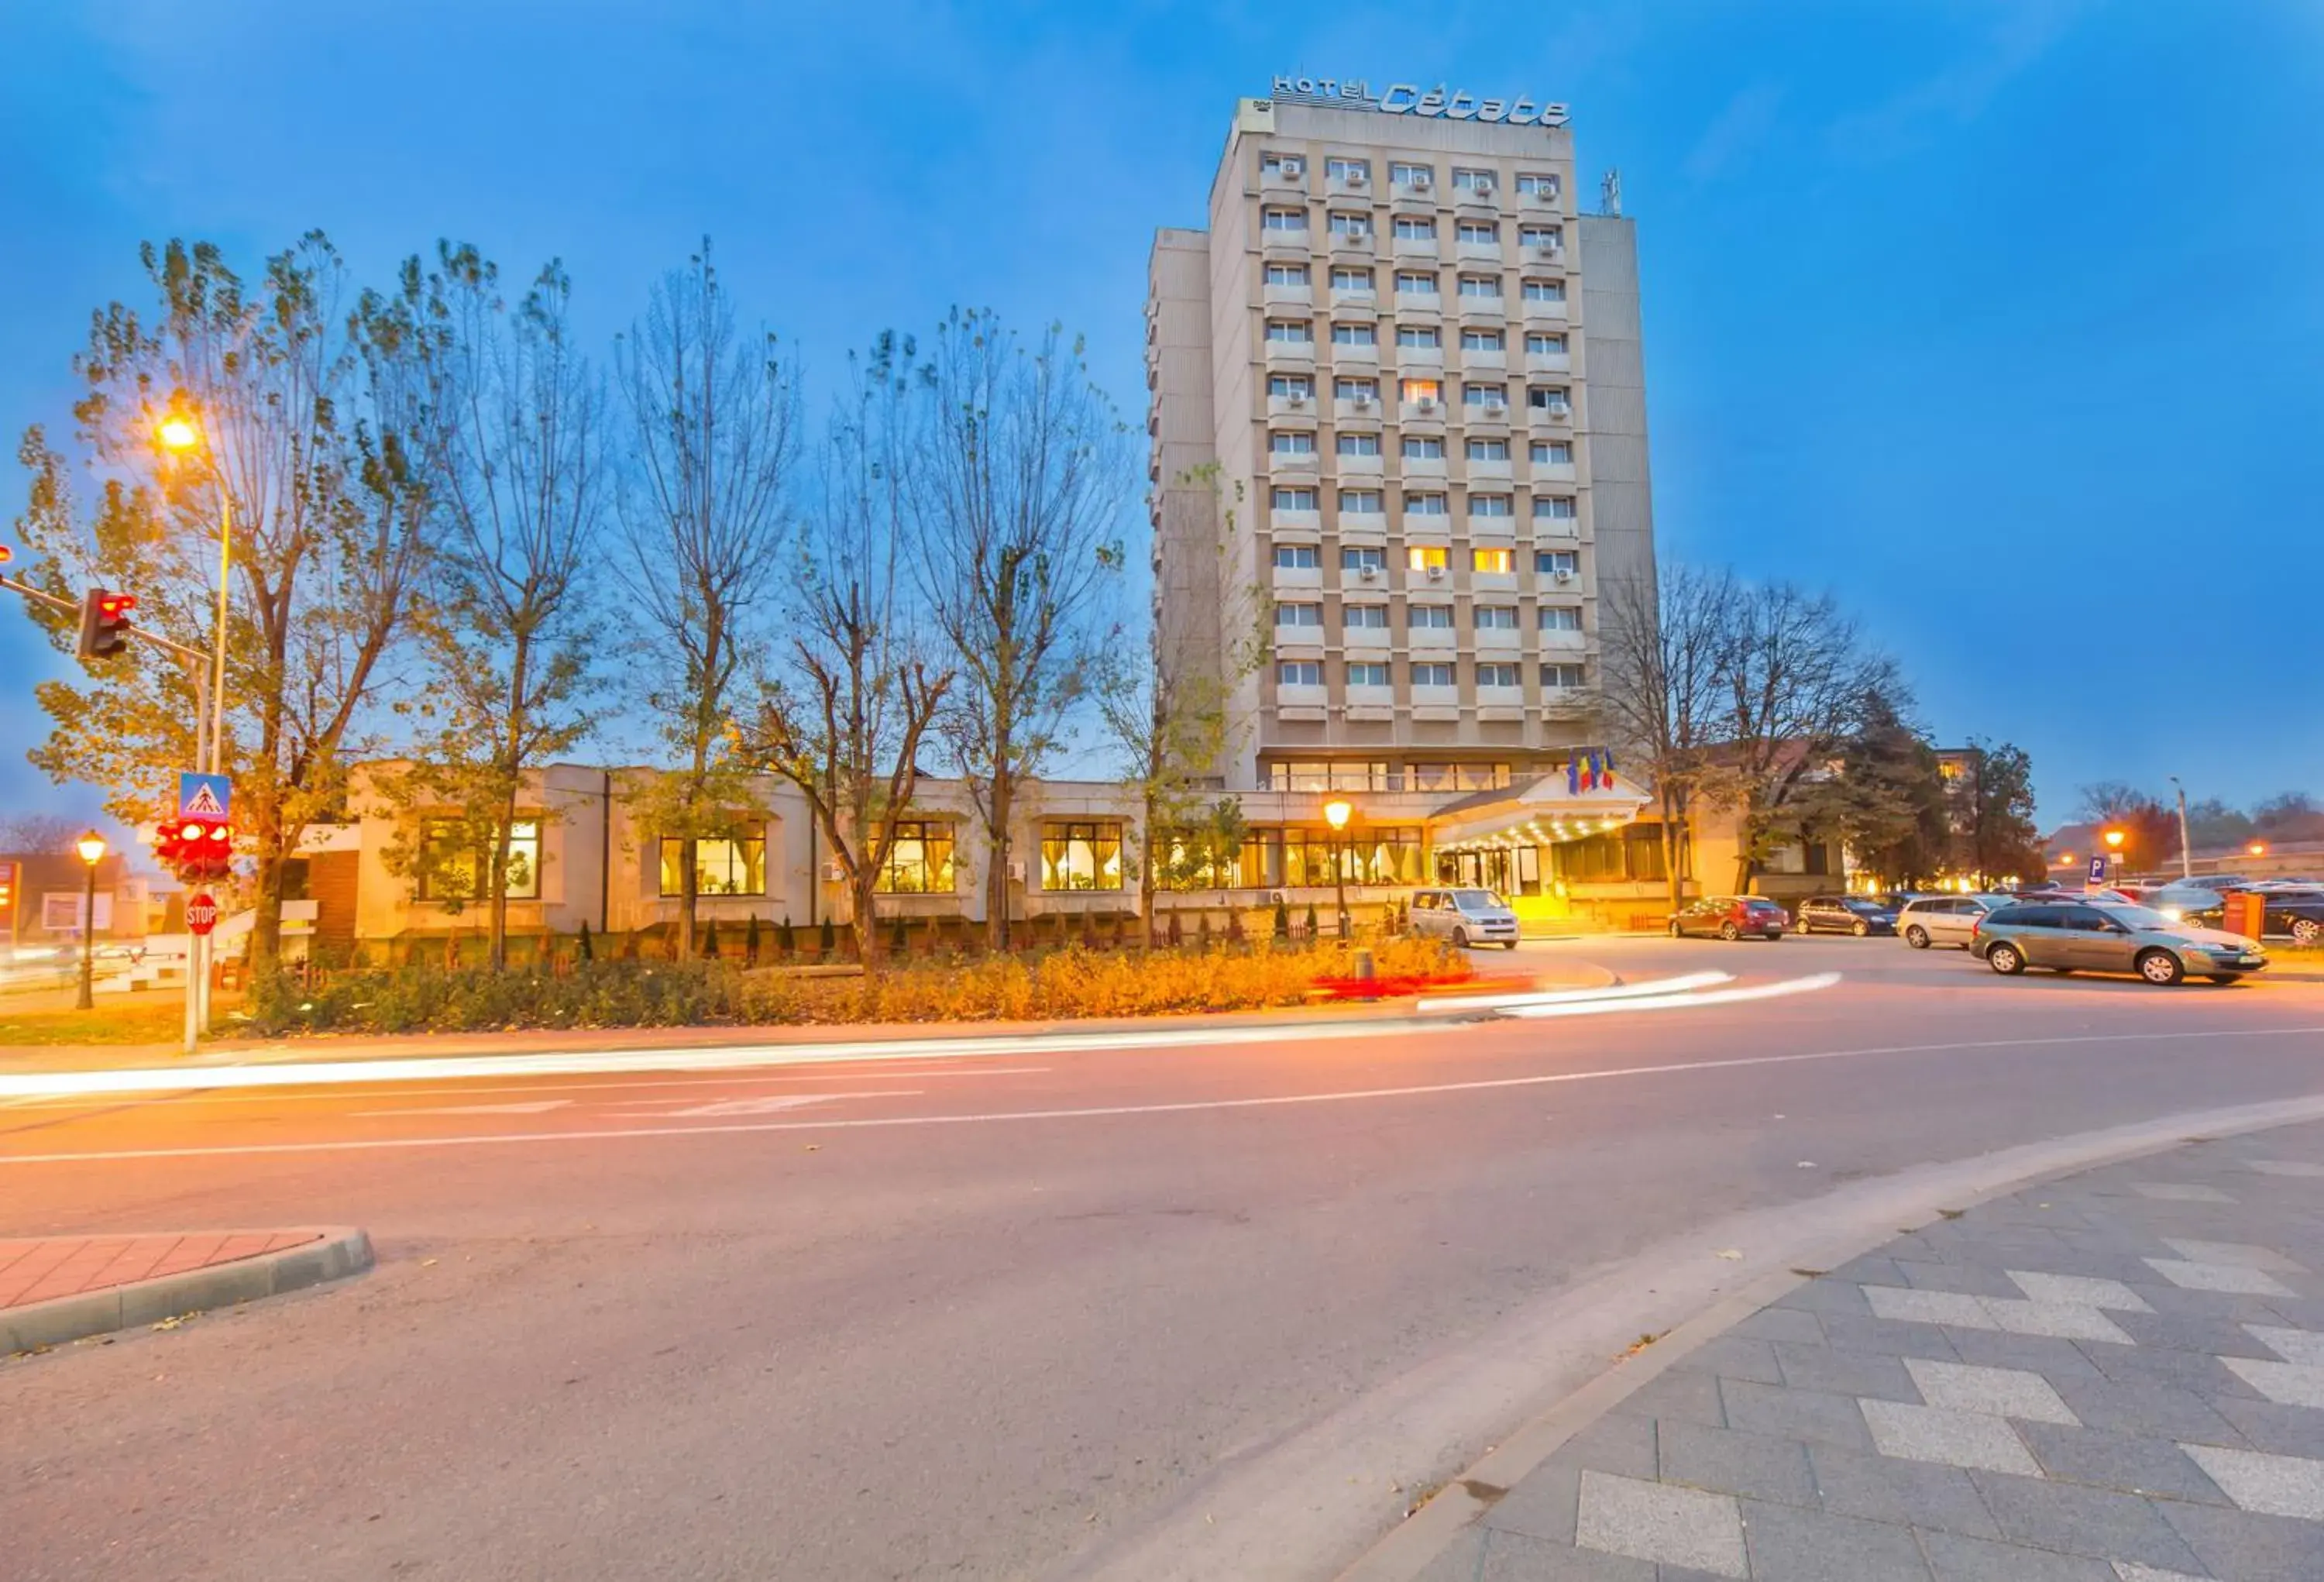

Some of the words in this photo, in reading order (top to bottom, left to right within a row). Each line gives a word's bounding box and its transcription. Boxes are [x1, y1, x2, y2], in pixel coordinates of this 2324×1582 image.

[1274, 75, 1380, 101] HOTEL
[2092, 860, 2102, 876] P
[187, 906, 216, 924] STOP
